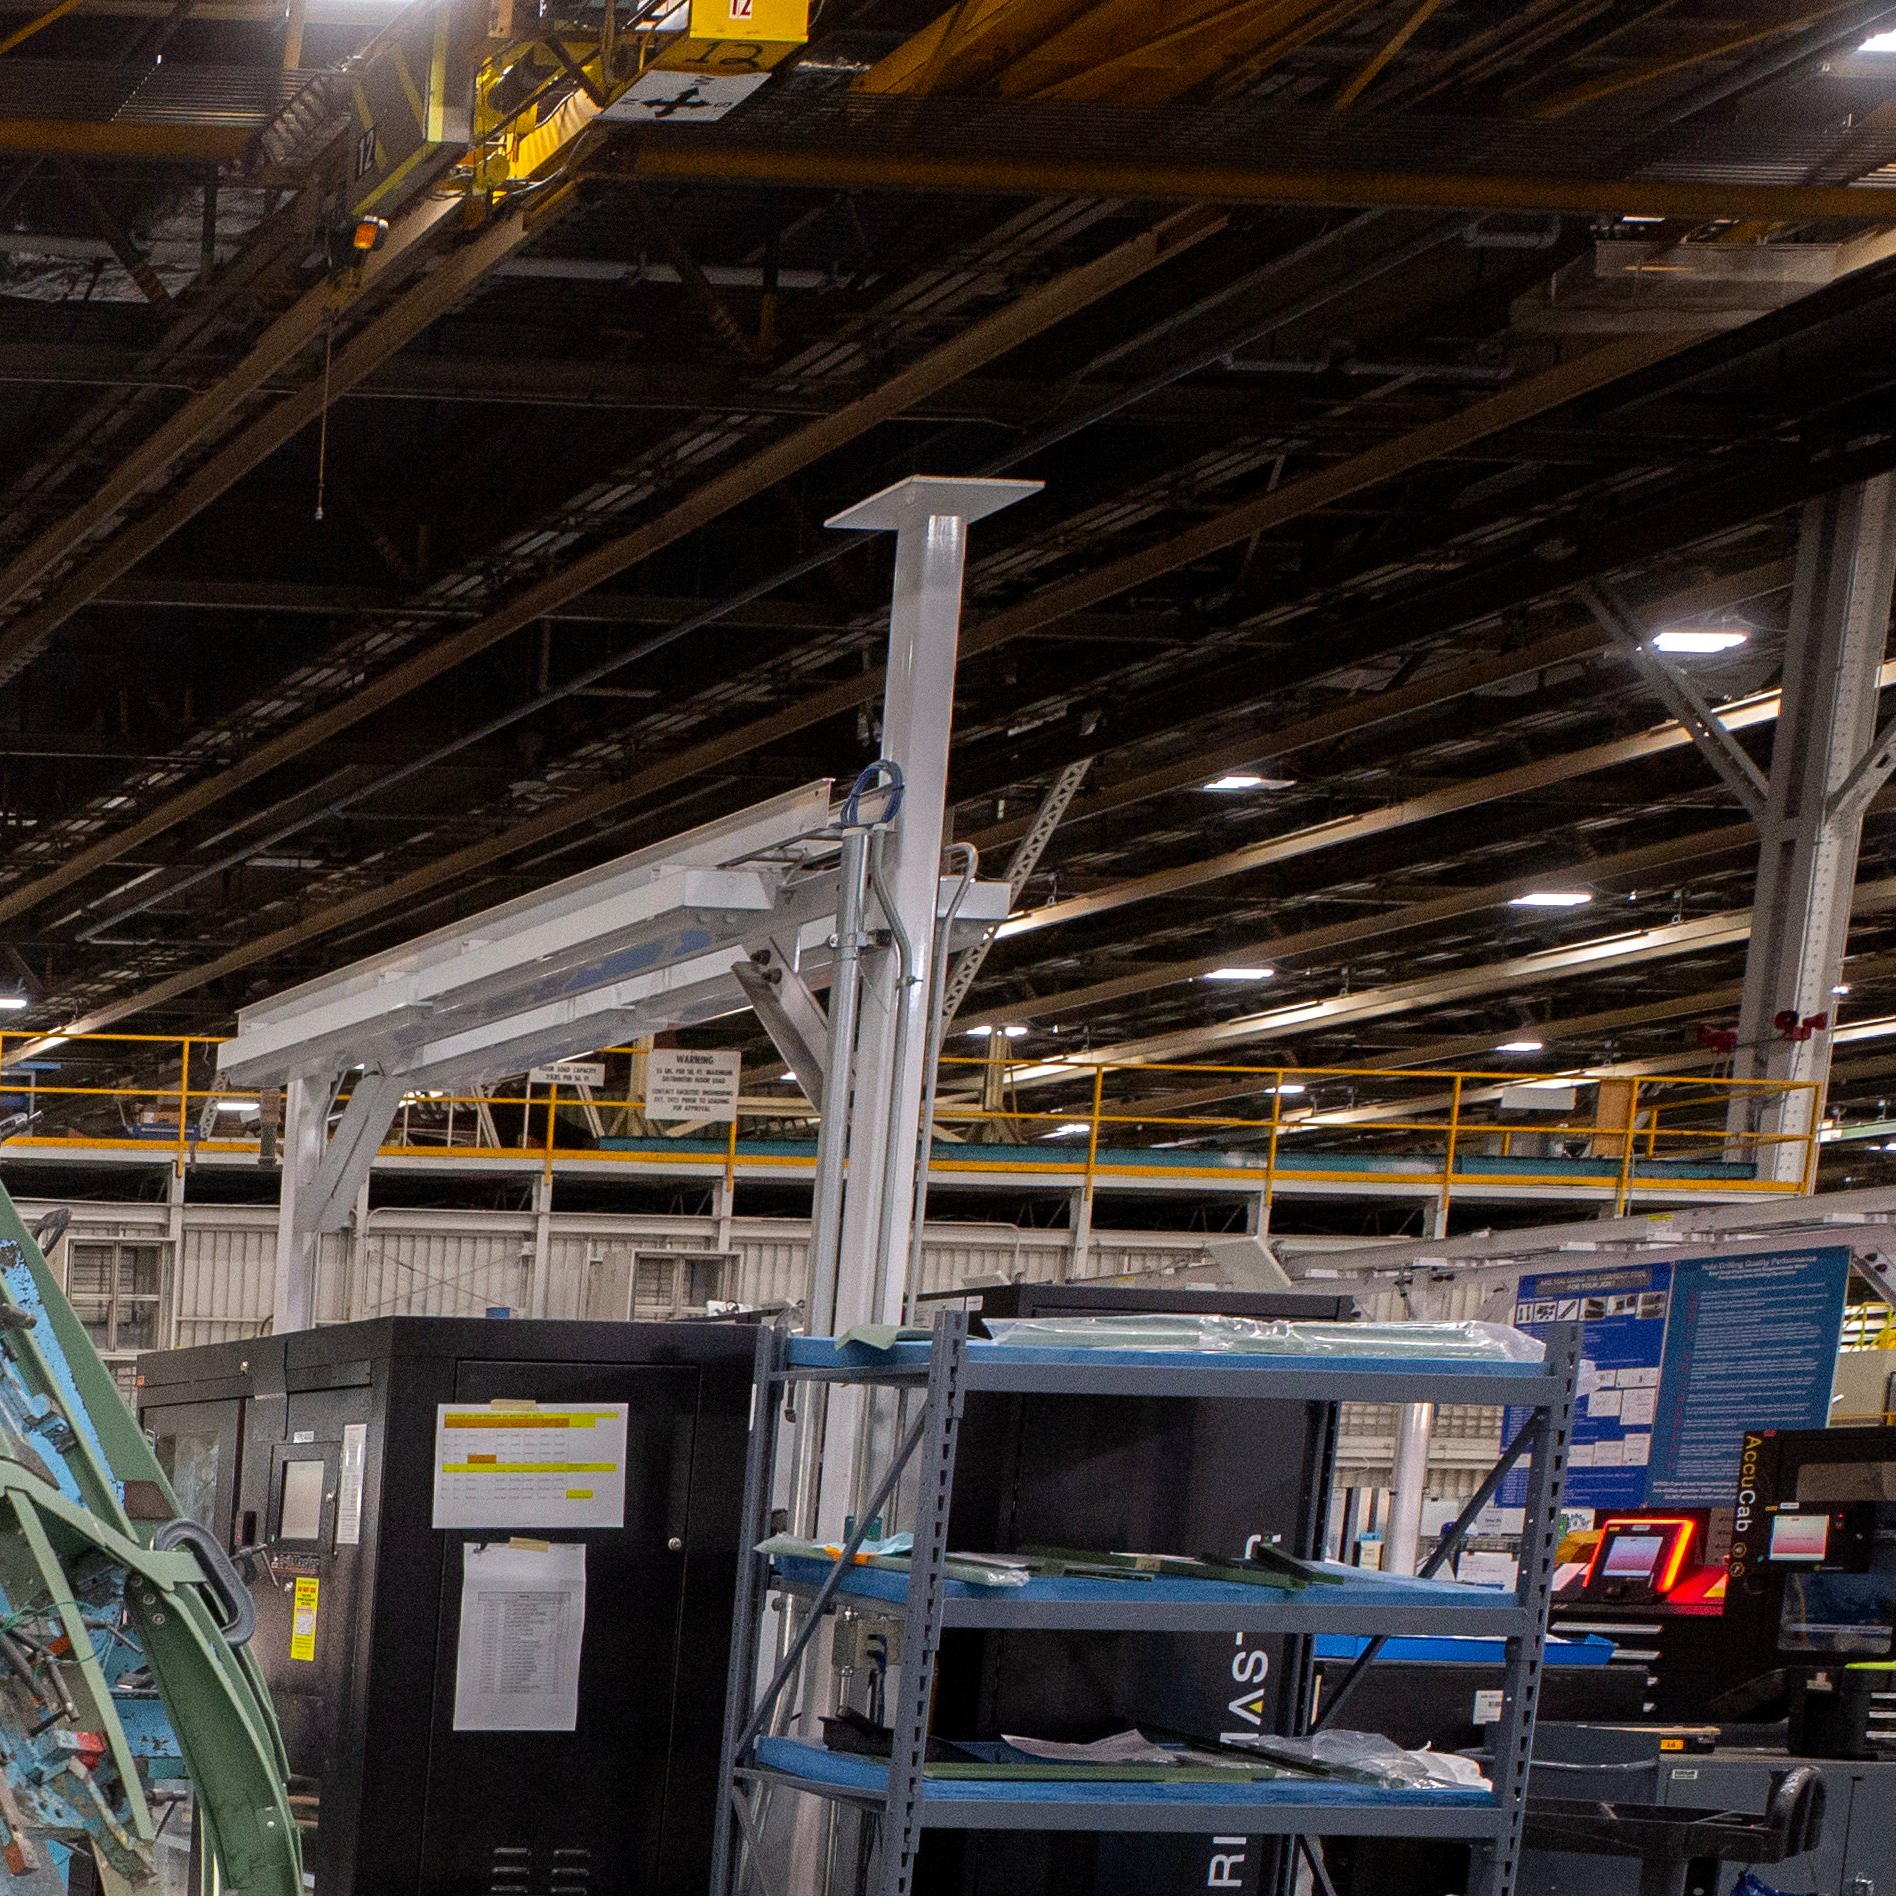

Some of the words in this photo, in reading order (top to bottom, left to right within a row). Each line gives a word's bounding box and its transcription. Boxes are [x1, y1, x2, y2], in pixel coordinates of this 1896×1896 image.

[730, 0, 752, 18] 12
[686, 42, 763, 70] 12
[676, 1055, 715, 1065] WARNING
[1735, 1435, 1762, 1532] AccuCab
